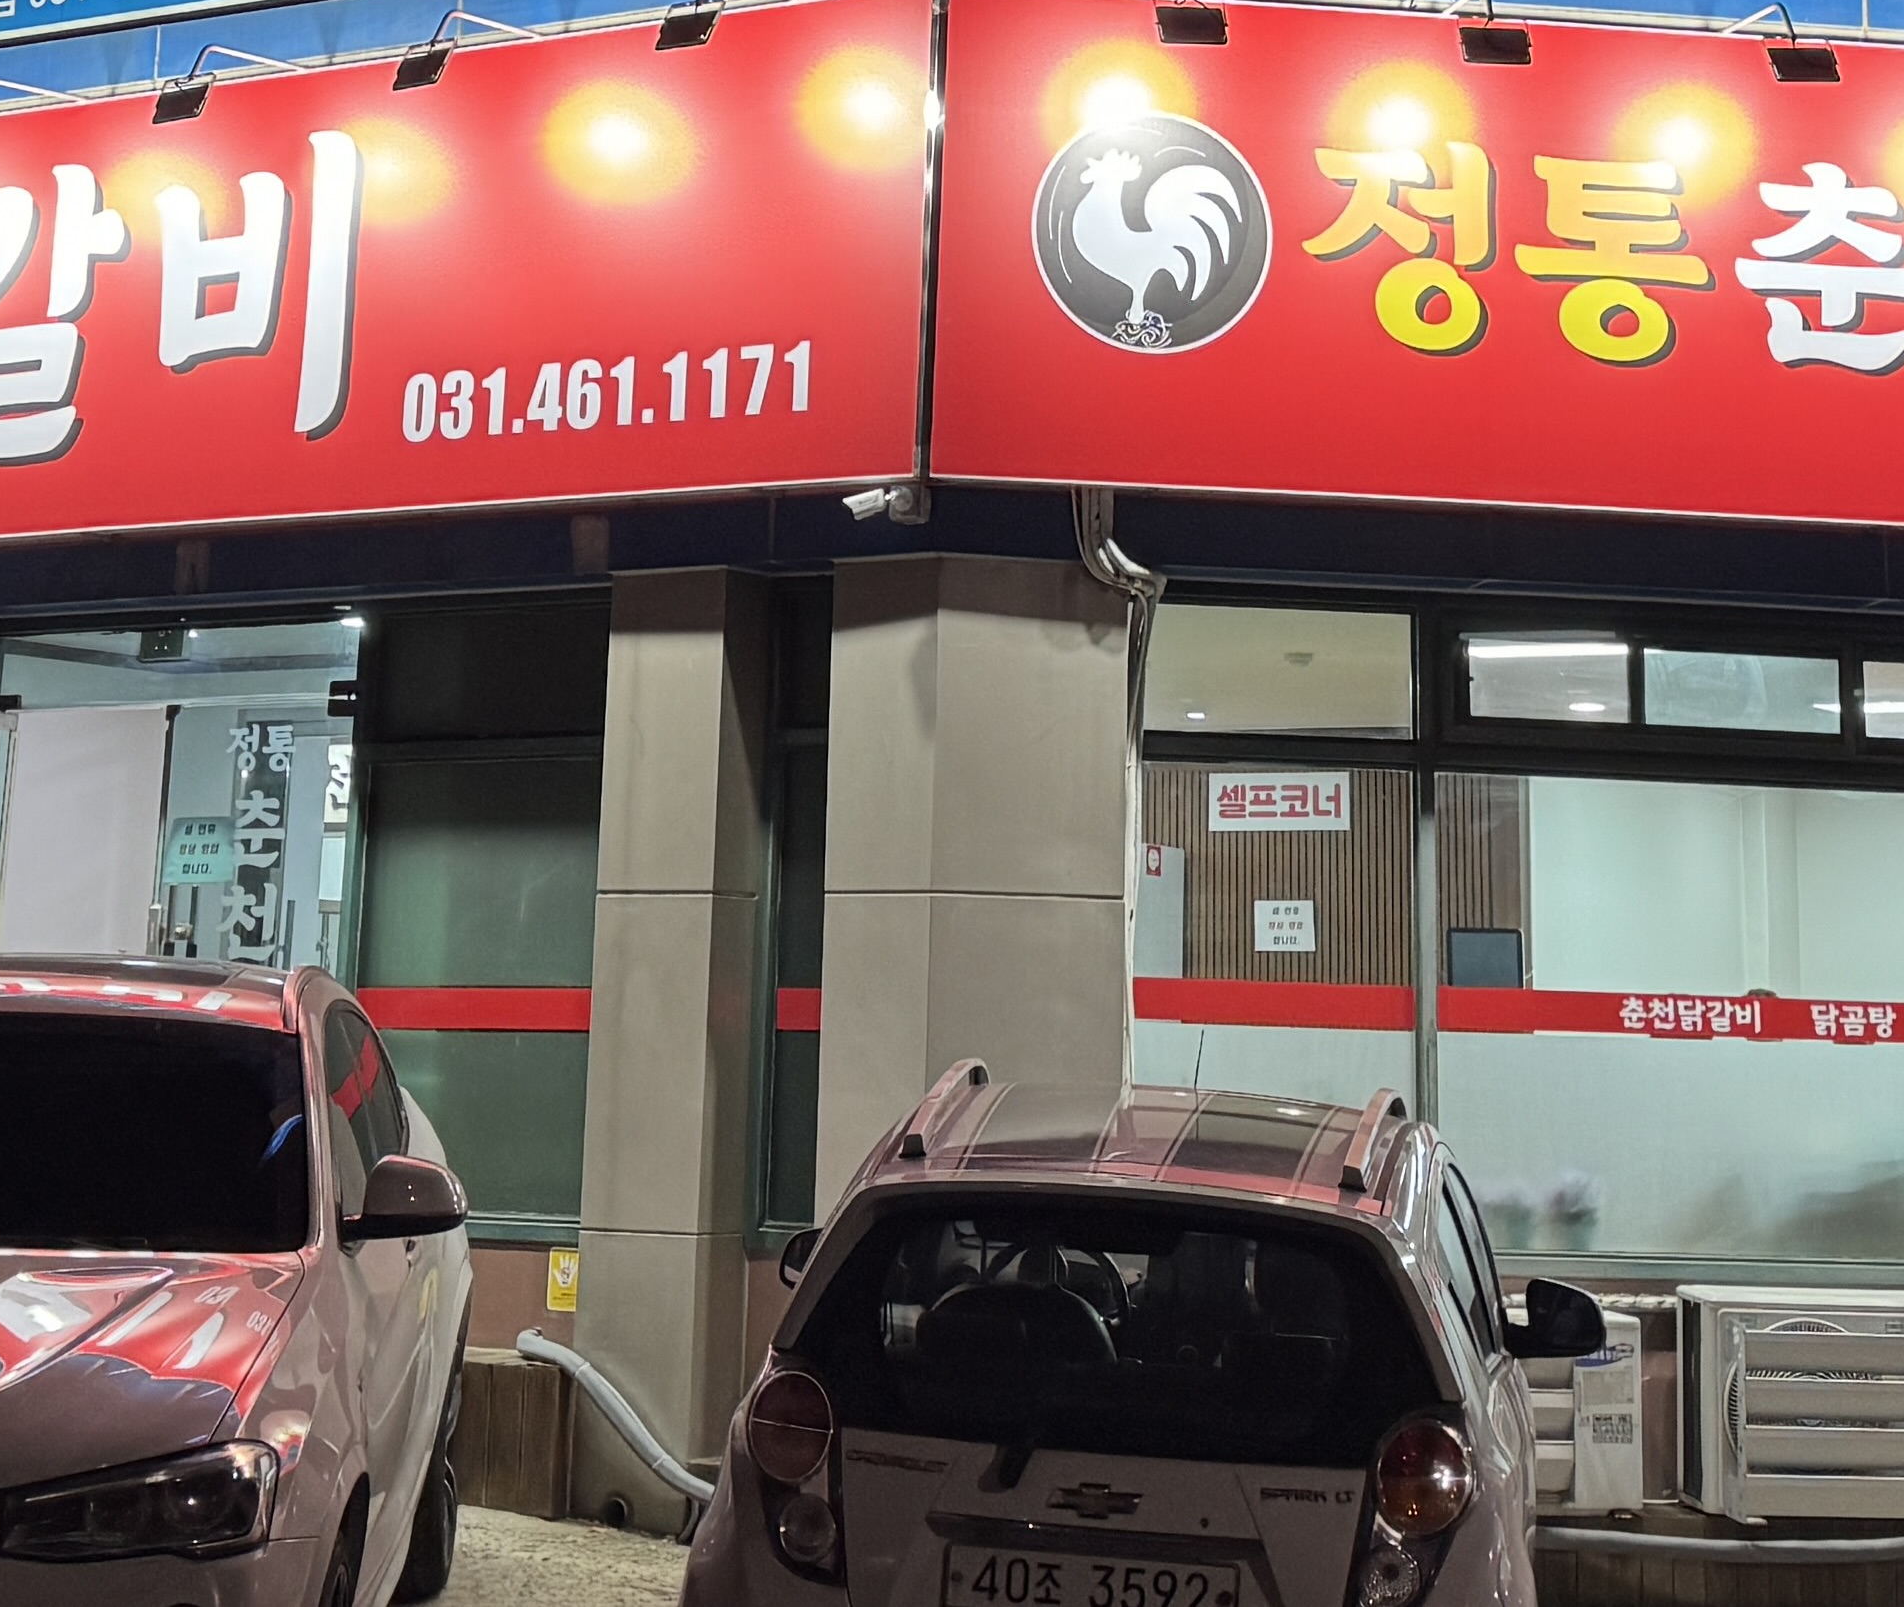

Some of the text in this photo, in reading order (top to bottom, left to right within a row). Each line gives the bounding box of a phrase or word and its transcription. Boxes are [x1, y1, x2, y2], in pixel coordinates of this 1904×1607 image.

[1302, 140, 1716, 364] 정통
[401, 340, 813, 444] 031.461.1171
[226, 724, 295, 773] 정통
[1216, 782, 1342, 820] 셀프코너
[1619, 996, 1762, 1034] 춘천닭갈비
[1811, 1003, 1896, 1037] 닭곰탕
[972, 1555, 1211, 1607] 40조 3592
